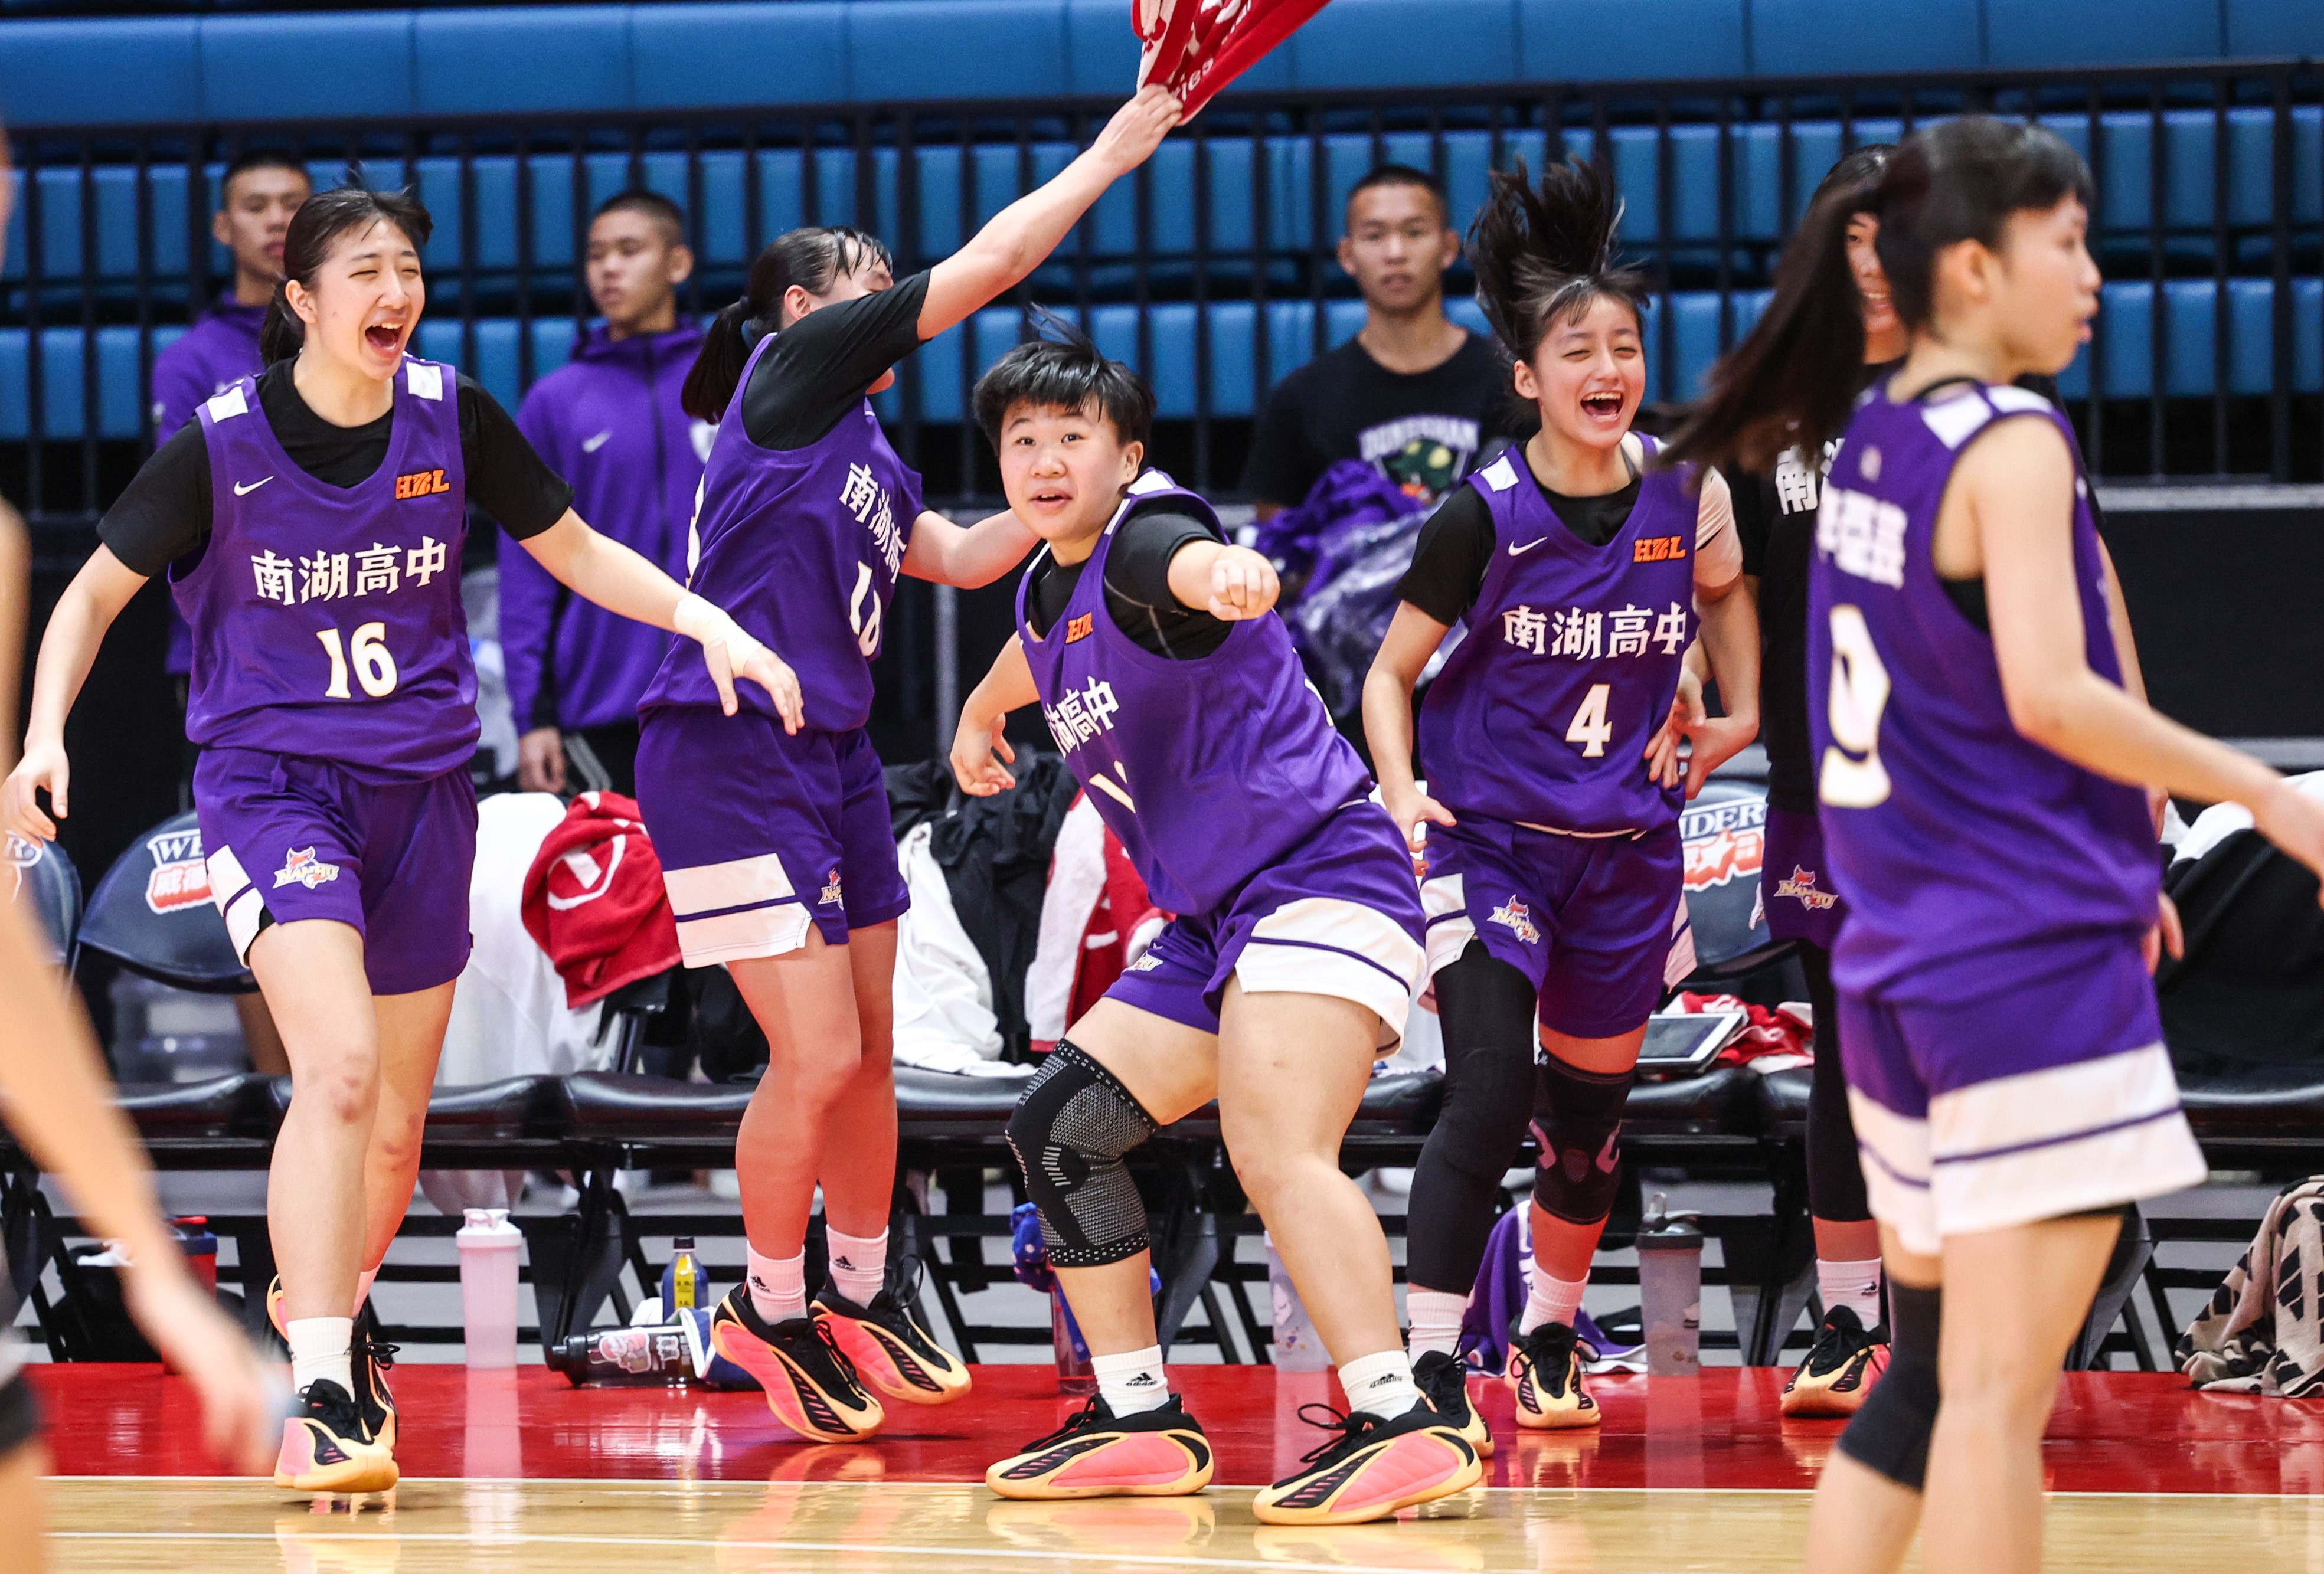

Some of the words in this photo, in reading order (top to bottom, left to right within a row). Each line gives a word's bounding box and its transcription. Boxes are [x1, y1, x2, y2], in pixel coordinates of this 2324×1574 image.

[395, 469, 450, 499] HBL
[839, 462, 907, 584] 南湖高
[1633, 536, 1686, 562] HBL
[251, 535, 447, 606] 南湖高中
[316, 621, 398, 699] 16
[1065, 611, 1093, 644] HB
[1502, 600, 1687, 661] 南湖高中
[1044, 675, 1120, 760] 湖高中
[1565, 683, 1612, 758] 4
[1679, 804, 1764, 842] IDER
